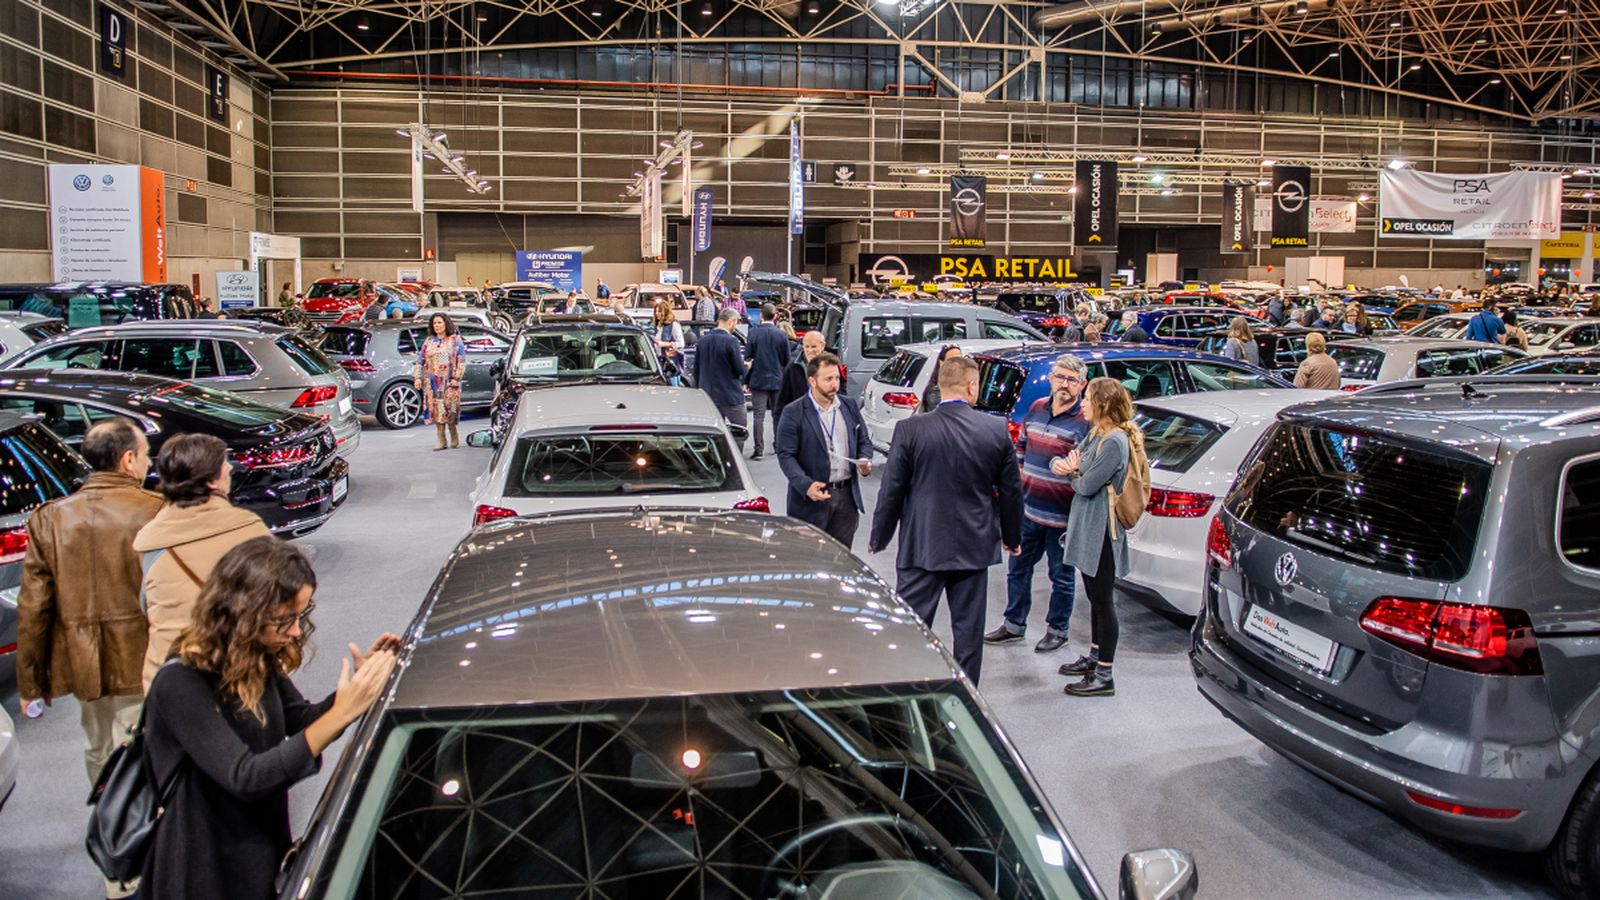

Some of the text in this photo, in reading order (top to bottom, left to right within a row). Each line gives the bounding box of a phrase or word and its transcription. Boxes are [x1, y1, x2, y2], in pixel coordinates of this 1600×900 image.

[110, 13, 120, 42] D
[216, 73, 222, 96] E
[1453, 179, 1492, 193] PSA
[1090, 164, 1102, 232] OPEL OCASIÓN
[698, 202, 709, 248] HYUNDAI
[1233, 221, 1242, 241] OPEL
[1393, 221, 1453, 232] OPEL OCASIÓN
[1271, 237, 1308, 245] PSA RETAIL
[940, 257, 1078, 278] PSA RETAIL
